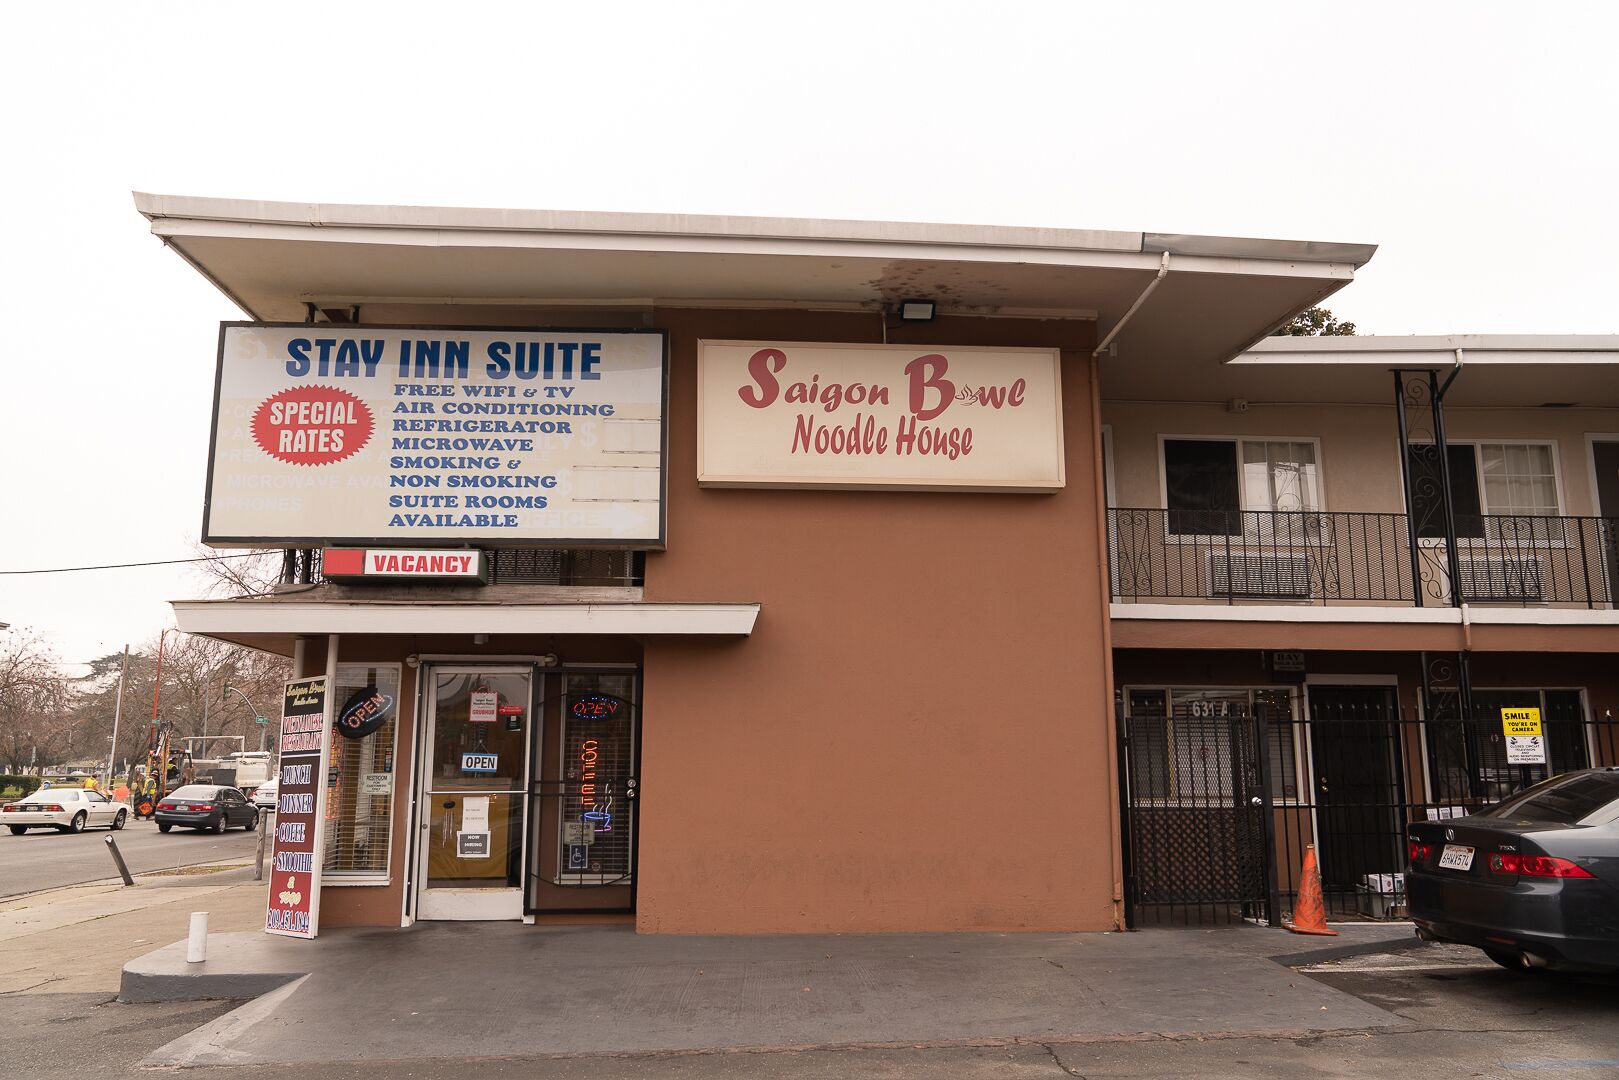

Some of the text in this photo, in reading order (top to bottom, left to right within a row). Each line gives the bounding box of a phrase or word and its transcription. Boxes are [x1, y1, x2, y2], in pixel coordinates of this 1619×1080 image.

[285, 338, 384, 378] STAY
[400, 341, 469, 378] INN
[486, 342, 601, 380] SUITE
[738, 348, 889, 413] Saigon
[394, 384, 575, 399] FREE WIFI & TV
[270, 402, 357, 425] SPECIAL
[393, 402, 615, 418] AIR CONDITIONING
[392, 419, 572, 435] REFRIGERATOR
[279, 428, 344, 453] RATES
[392, 438, 533, 452] MICROWAVE
[791, 413, 974, 461] Noodle House
[390, 456, 521, 471] SMOKING &
[390, 475, 557, 489] NON SMOKING
[389, 494, 547, 509] SUITE ROOMS
[388, 514, 518, 528] AVAILABLE
[373, 555, 472, 573] VACANCY
[348, 692, 386, 728] OPEN
[573, 702, 618, 714] OPEN
[1192, 701, 1215, 717] 631
[465, 756, 495, 769] OPEN
[282, 764, 312, 785] LUNCH
[581, 740, 598, 805] COFFEE
[280, 793, 313, 813] DINNER
